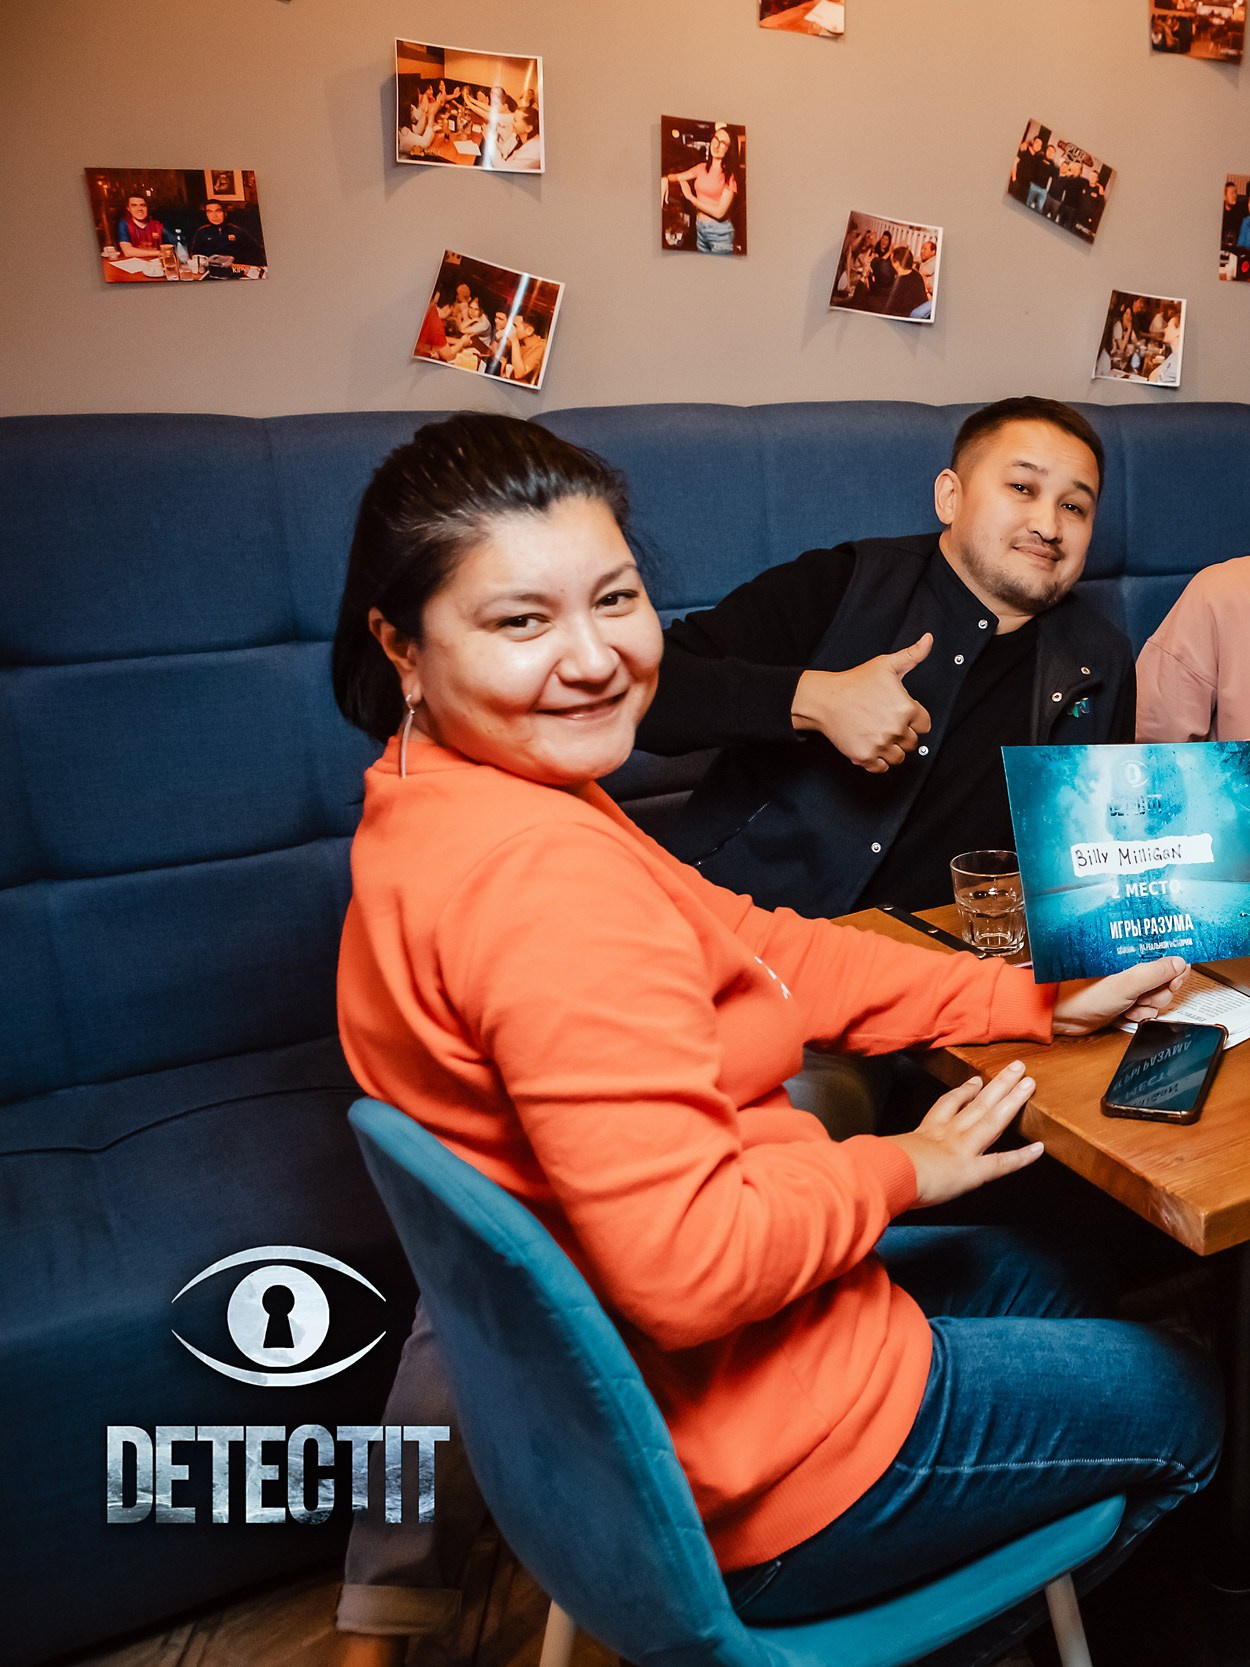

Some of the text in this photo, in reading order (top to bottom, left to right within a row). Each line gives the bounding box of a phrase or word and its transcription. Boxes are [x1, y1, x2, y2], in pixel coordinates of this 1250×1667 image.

[1075, 848, 1109, 867] Billy
[1125, 879, 1182, 897] МЕСТО
[1110, 913, 1194, 939] ИГРЫ РАЗУМА
